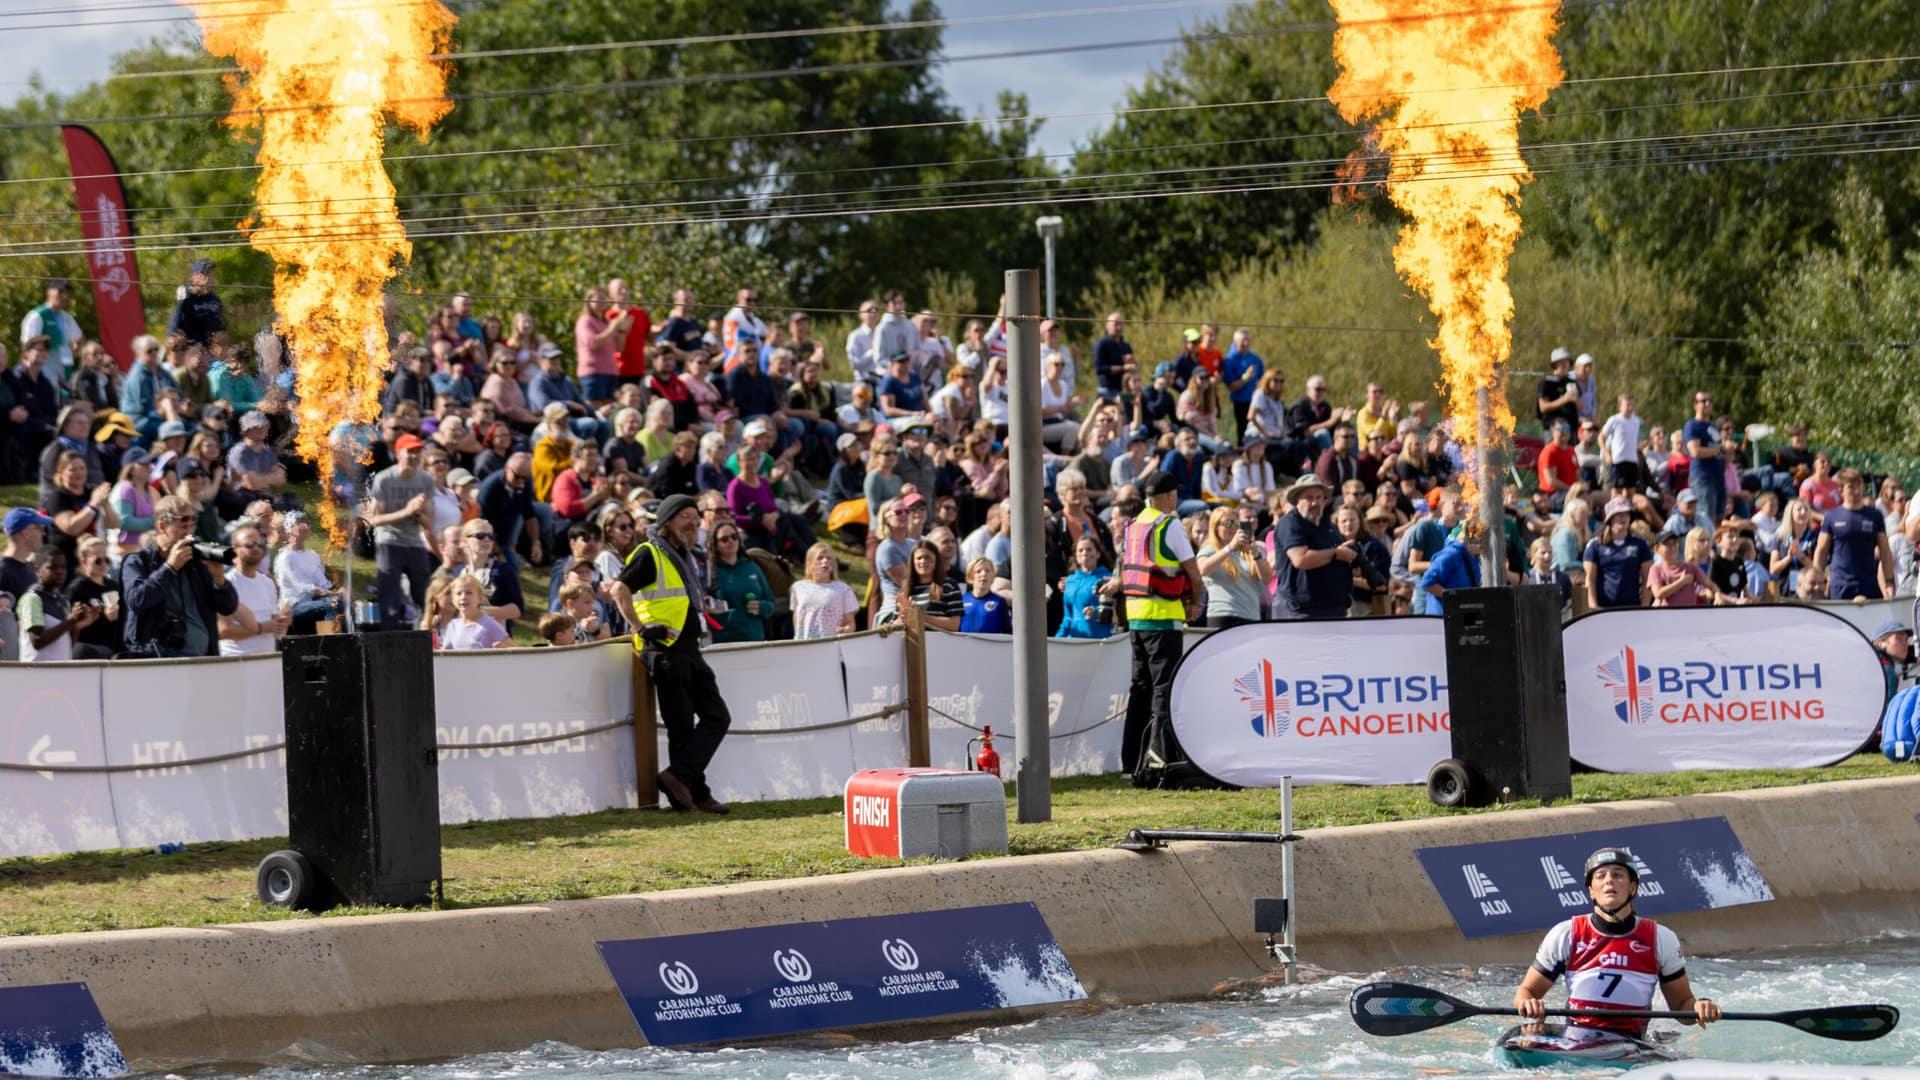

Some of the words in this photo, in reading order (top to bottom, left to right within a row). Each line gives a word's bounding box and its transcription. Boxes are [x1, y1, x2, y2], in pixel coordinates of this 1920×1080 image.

[1658, 662, 1822, 698] BRITISH
[1295, 674, 1449, 712] BRITISH
[1660, 699, 1824, 723] CANOEING
[853, 796, 889, 827] FINISH
[1558, 890, 1588, 907] ALDI
[1480, 899, 1512, 917] ALDI
[1599, 951, 1628, 967] Gill
[882, 973, 925, 986] CARAVAN
[926, 970, 945, 981] AND
[1597, 972, 1623, 998] 7
[773, 984, 817, 998] CARAVAN
[819, 981, 839, 992] AND
[879, 982, 938, 997] MOTORHOME
[937, 979, 960, 990] CLUB
[659, 997, 704, 1010] CARAVAN
[706, 994, 727, 1006] AND
[769, 994, 831, 1009] MOTORHOME
[831, 990, 853, 1001] CLUB
[655, 1006, 718, 1021] MOTORHOME
[718, 1003, 742, 1014] CLUB
